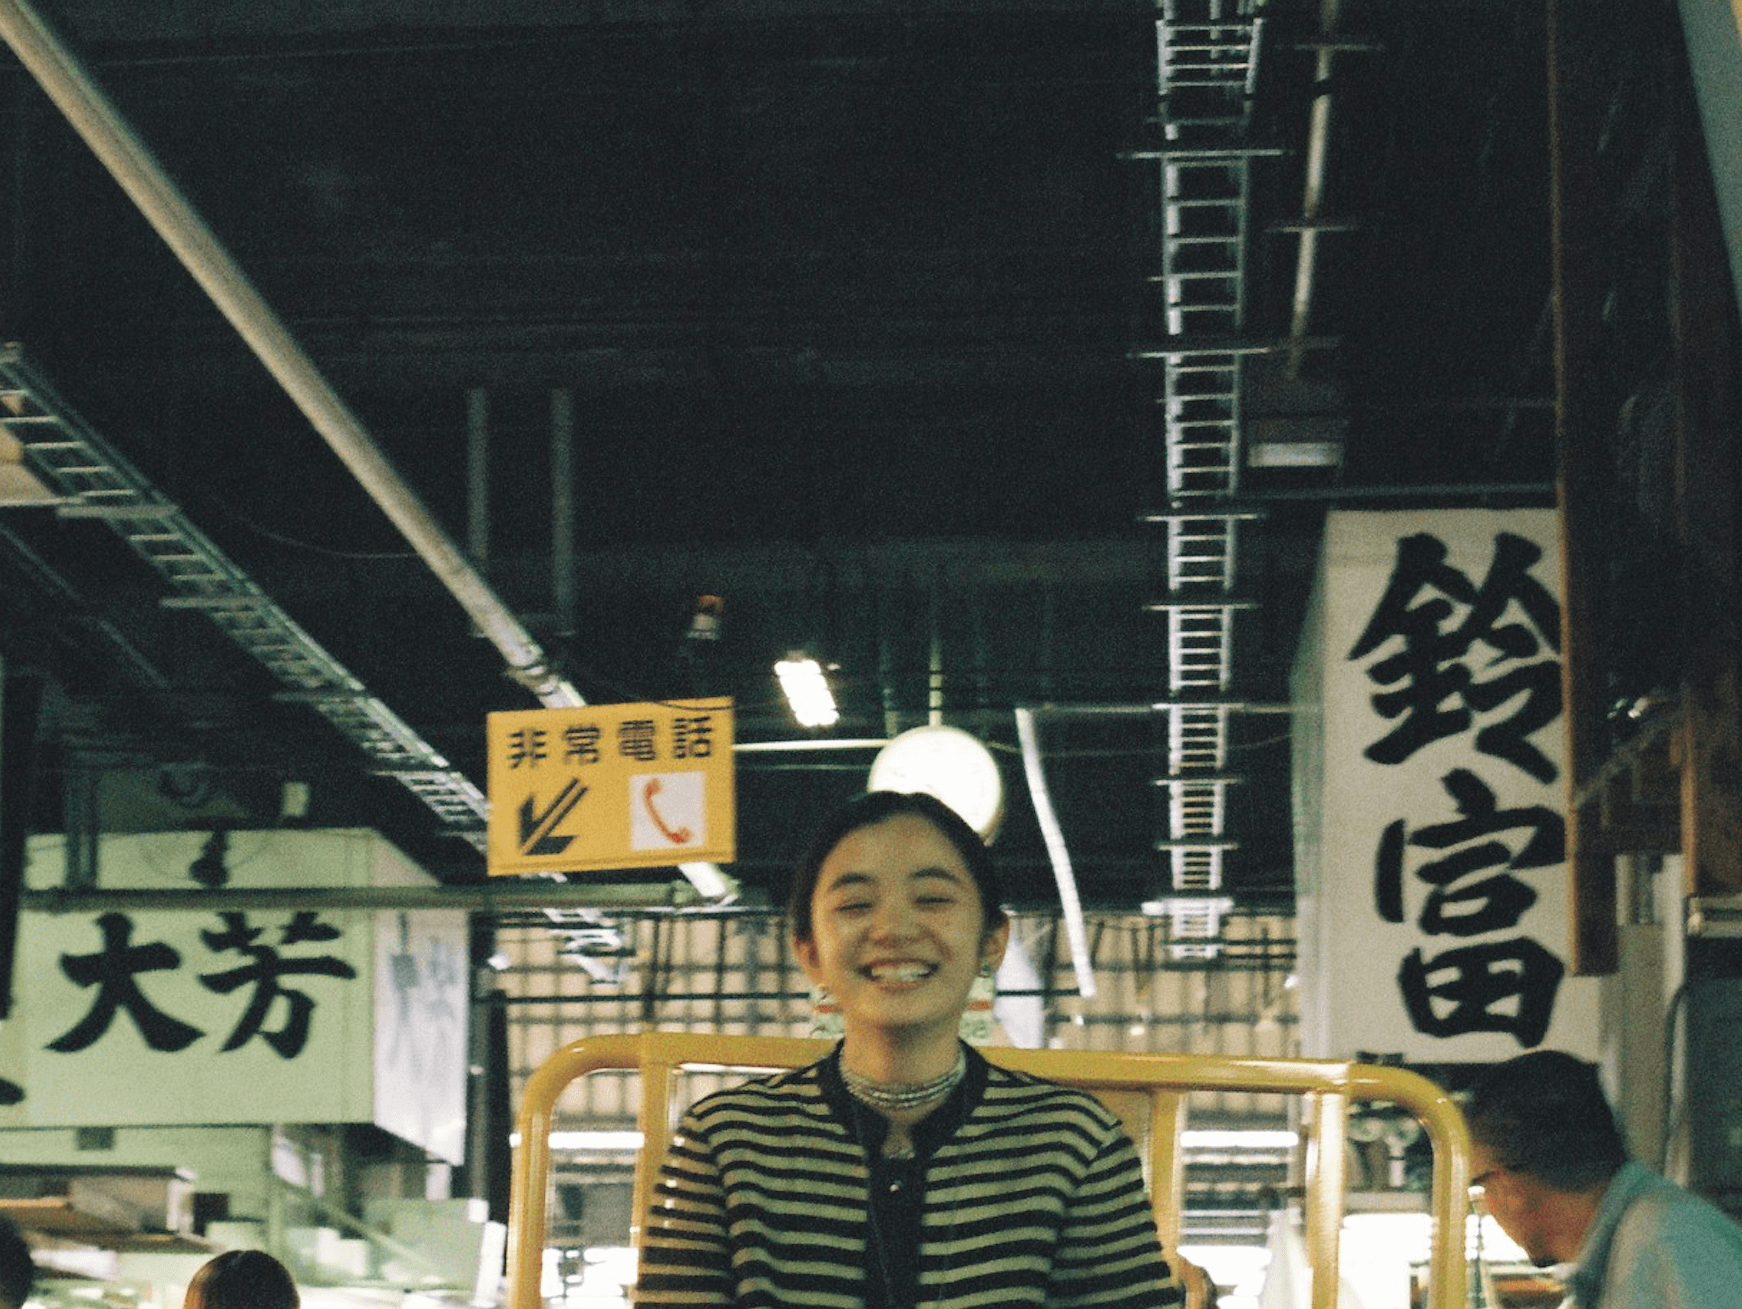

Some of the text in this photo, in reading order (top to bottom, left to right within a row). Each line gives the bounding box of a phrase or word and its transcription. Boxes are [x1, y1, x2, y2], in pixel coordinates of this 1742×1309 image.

[508, 716, 713, 769] 非常電話
[43, 912, 357, 1059] 大芳
